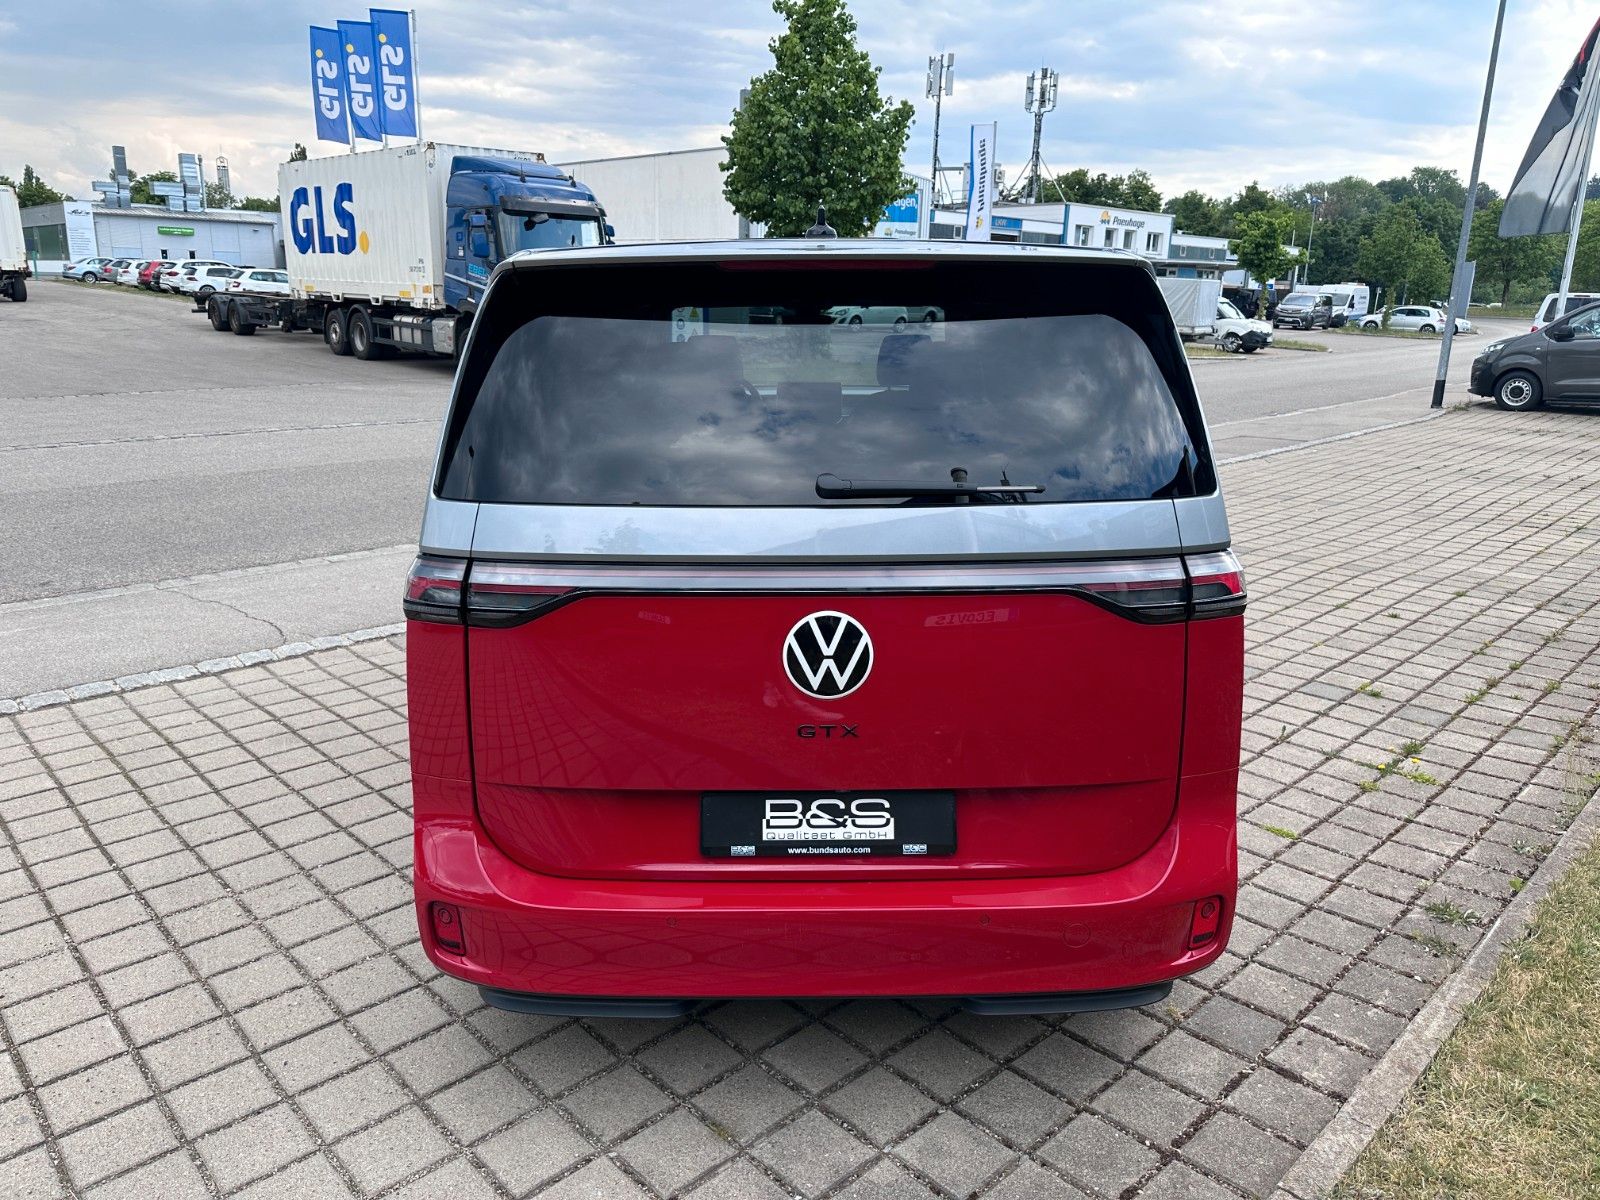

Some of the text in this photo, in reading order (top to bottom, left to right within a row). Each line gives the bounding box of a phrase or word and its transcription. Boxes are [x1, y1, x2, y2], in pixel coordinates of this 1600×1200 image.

[1112, 216, 1145, 229] Pneuhage
[798, 724, 859, 738] GTX
[766, 799, 891, 829] B&S
[766, 830, 888, 840] Qualitaet GmbH
[787, 846, 871, 854] www.bundsauto.com
